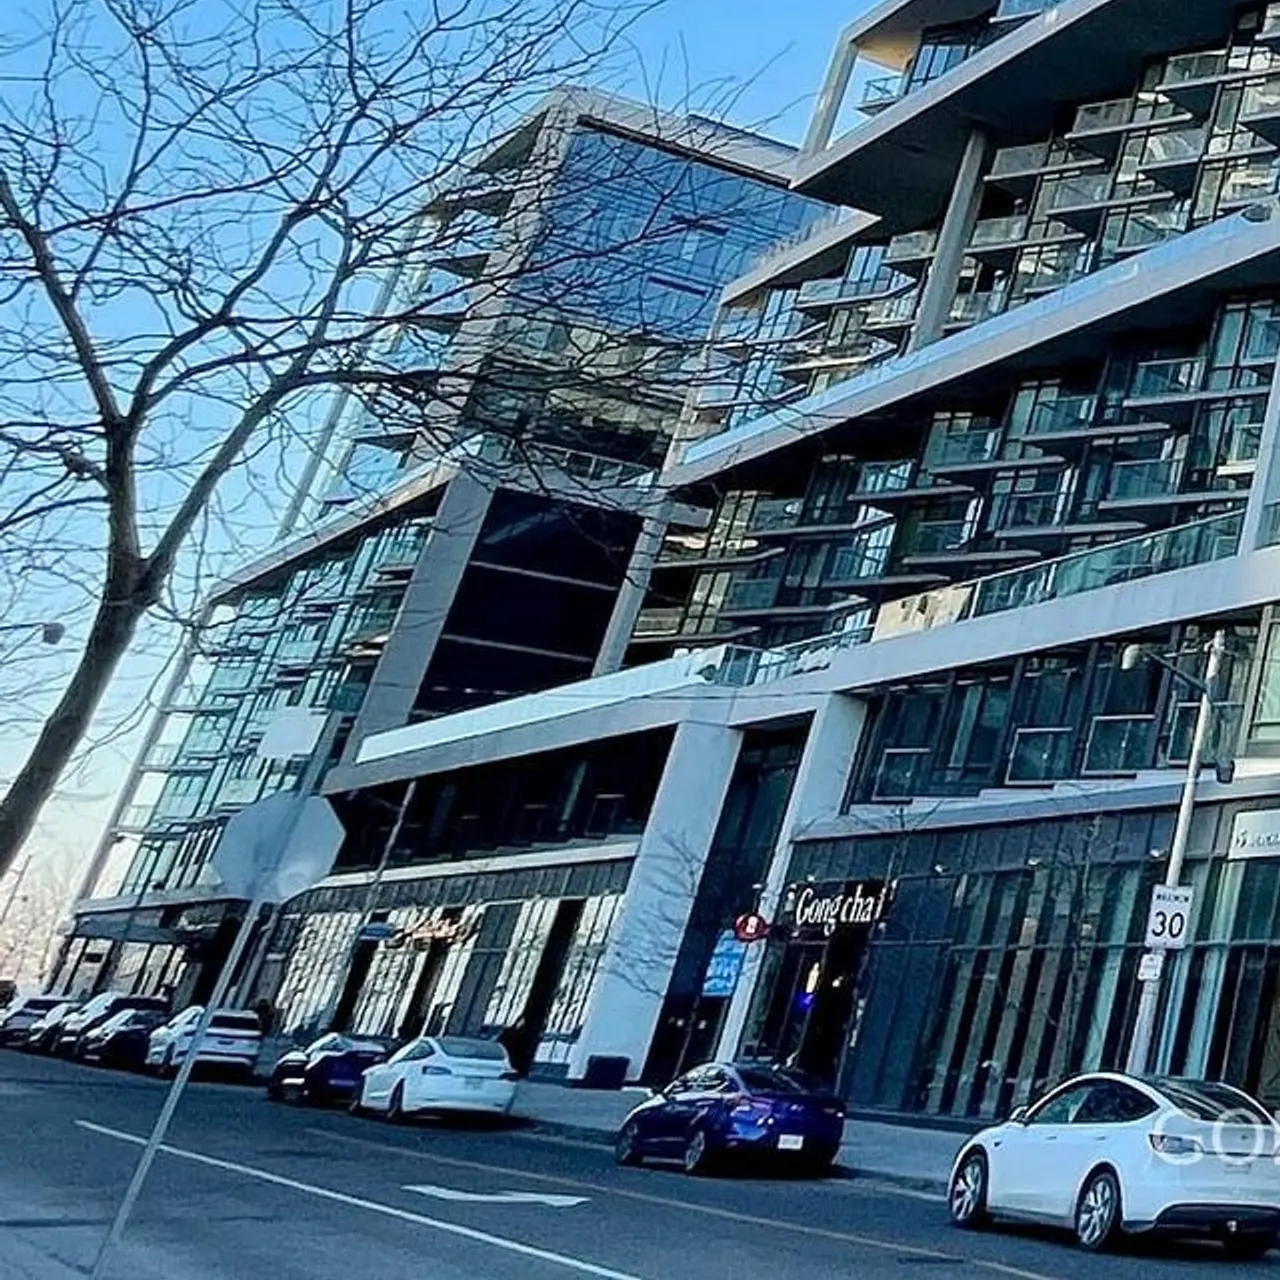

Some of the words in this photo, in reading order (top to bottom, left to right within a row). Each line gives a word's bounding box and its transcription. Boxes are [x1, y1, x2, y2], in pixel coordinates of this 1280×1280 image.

[796, 887, 844, 937] Gong
[840, 883, 875, 923] cha
[1151, 910, 1185, 938] 30
